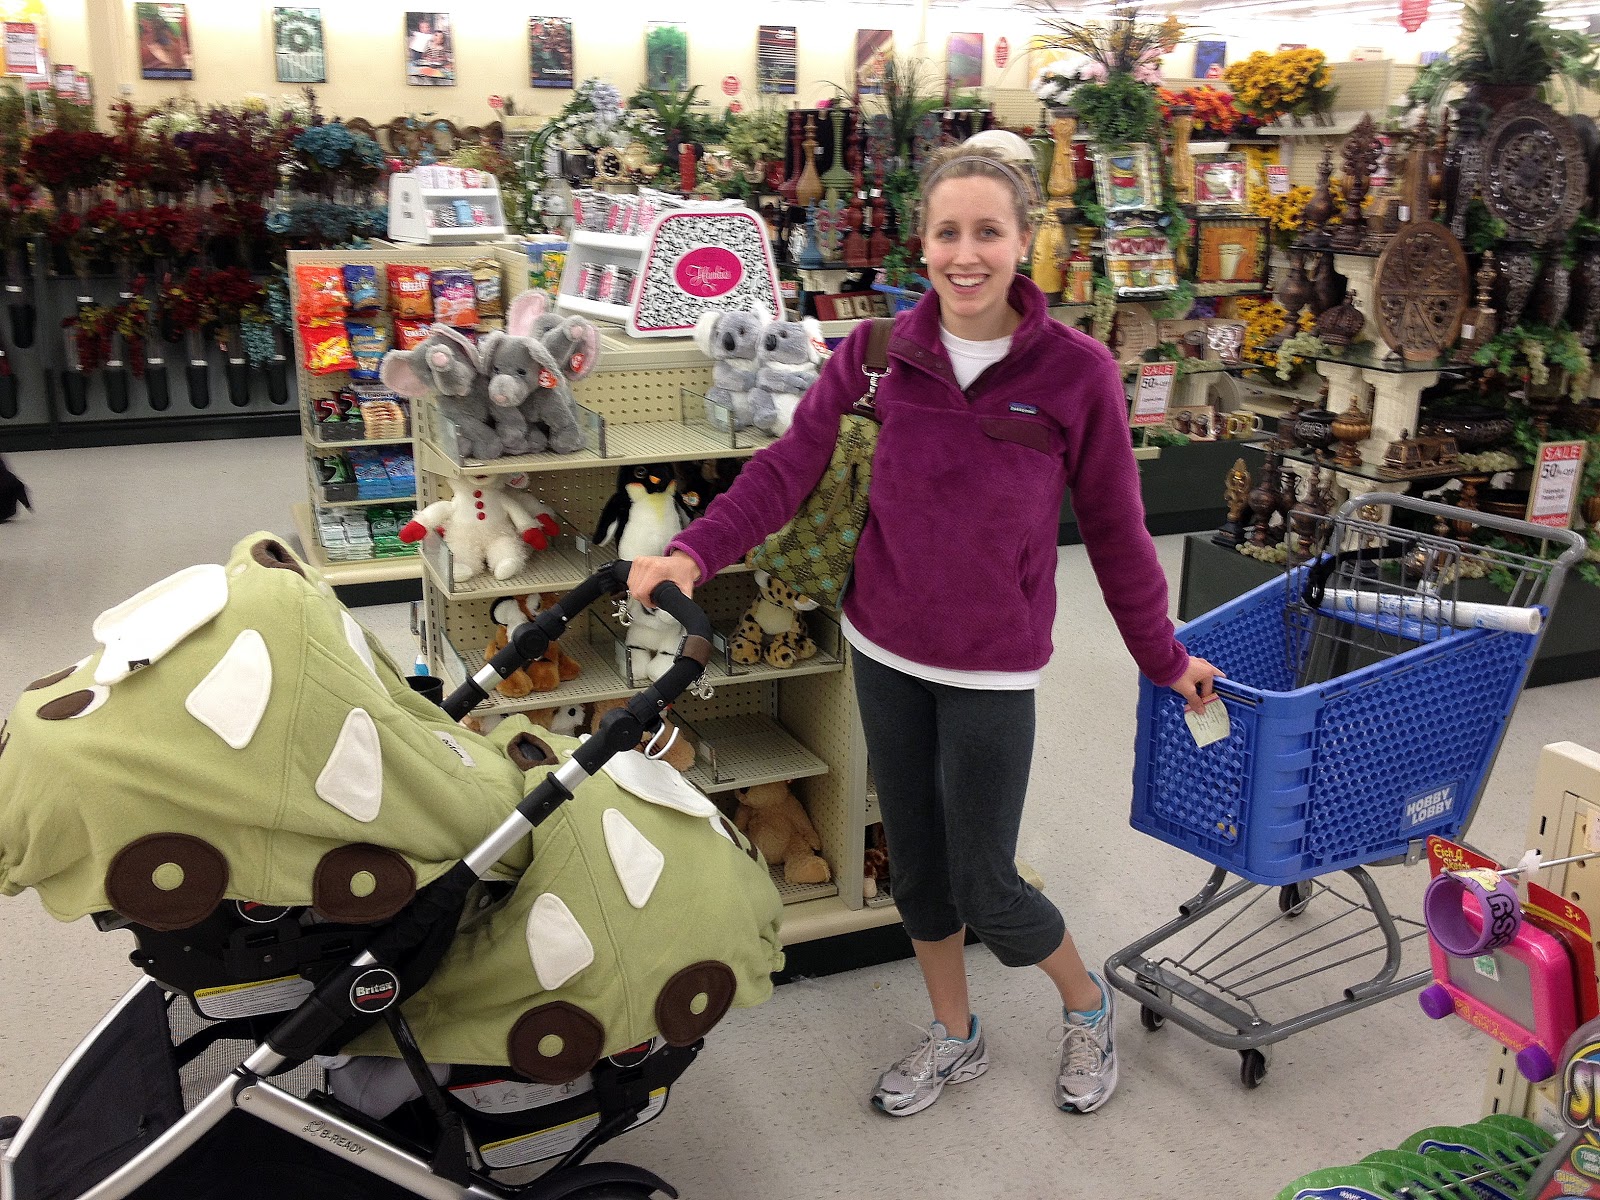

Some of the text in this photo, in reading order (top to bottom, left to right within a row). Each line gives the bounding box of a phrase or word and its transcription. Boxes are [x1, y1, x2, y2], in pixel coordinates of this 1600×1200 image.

[1143, 364, 1174, 375] SALE
[1544, 446, 1580, 460] SALE
[1406, 787, 1450, 816] HOBBY
[1411, 796, 1453, 825] LOBBY
[1433, 843, 1454, 859] Etch
[1564, 905, 1581, 922] 3+
[355, 981, 393, 997] Britax
[319, 1129, 368, 1156] B-READY
